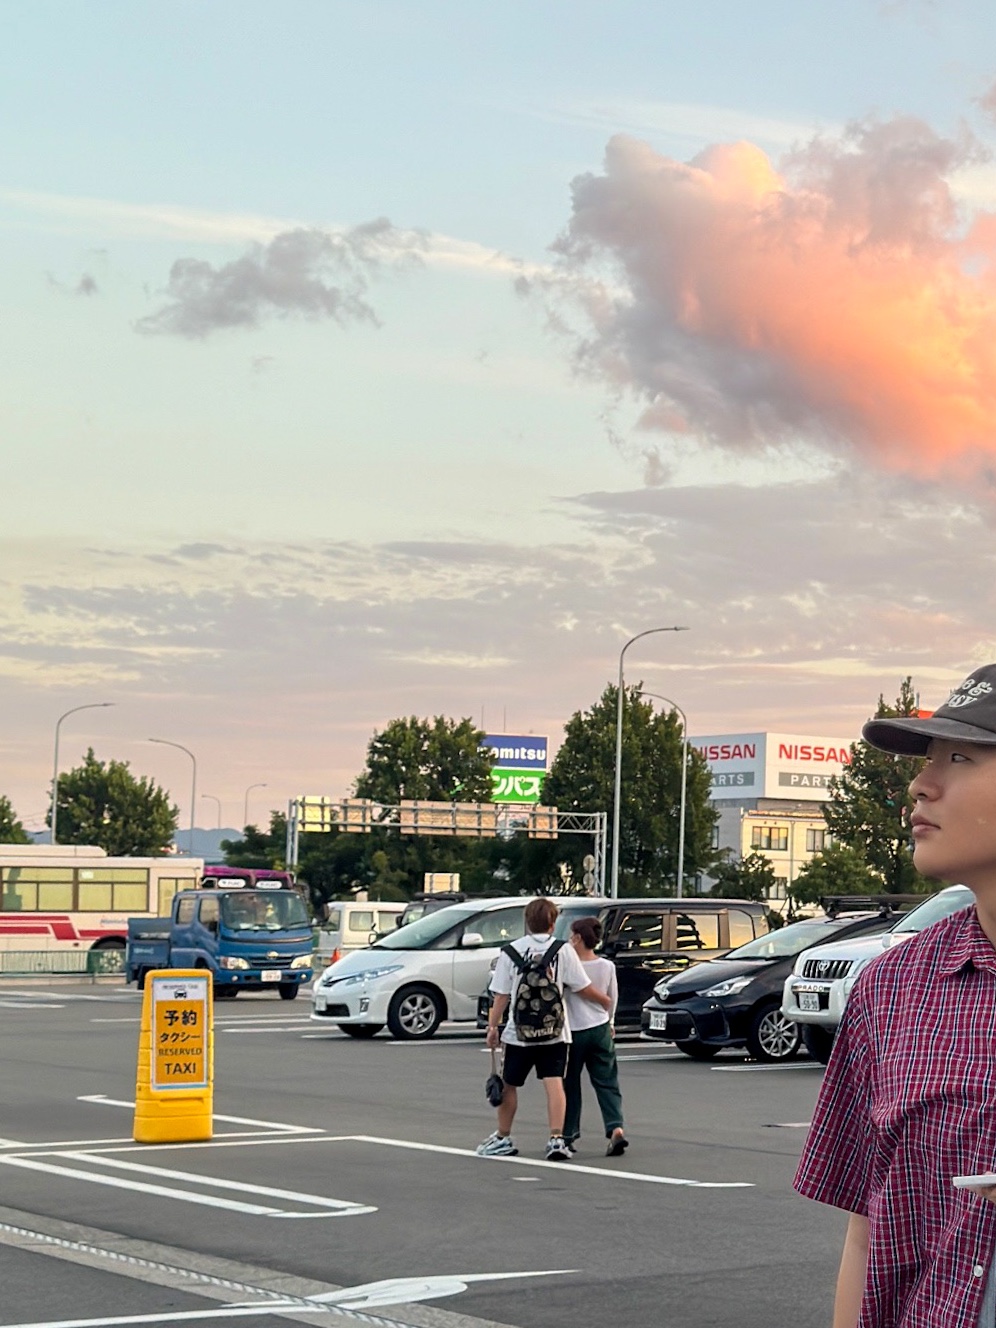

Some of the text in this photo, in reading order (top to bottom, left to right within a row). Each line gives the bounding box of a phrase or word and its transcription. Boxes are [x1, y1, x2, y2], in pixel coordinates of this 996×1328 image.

[779, 744, 851, 764] NISSAN
[790, 774, 831, 787] PART
[164, 1009, 198, 1026] 予約
[160, 1032, 201, 1043] タクシー
[158, 1047, 203, 1057] RESERVED
[165, 1062, 197, 1075] TAXI
